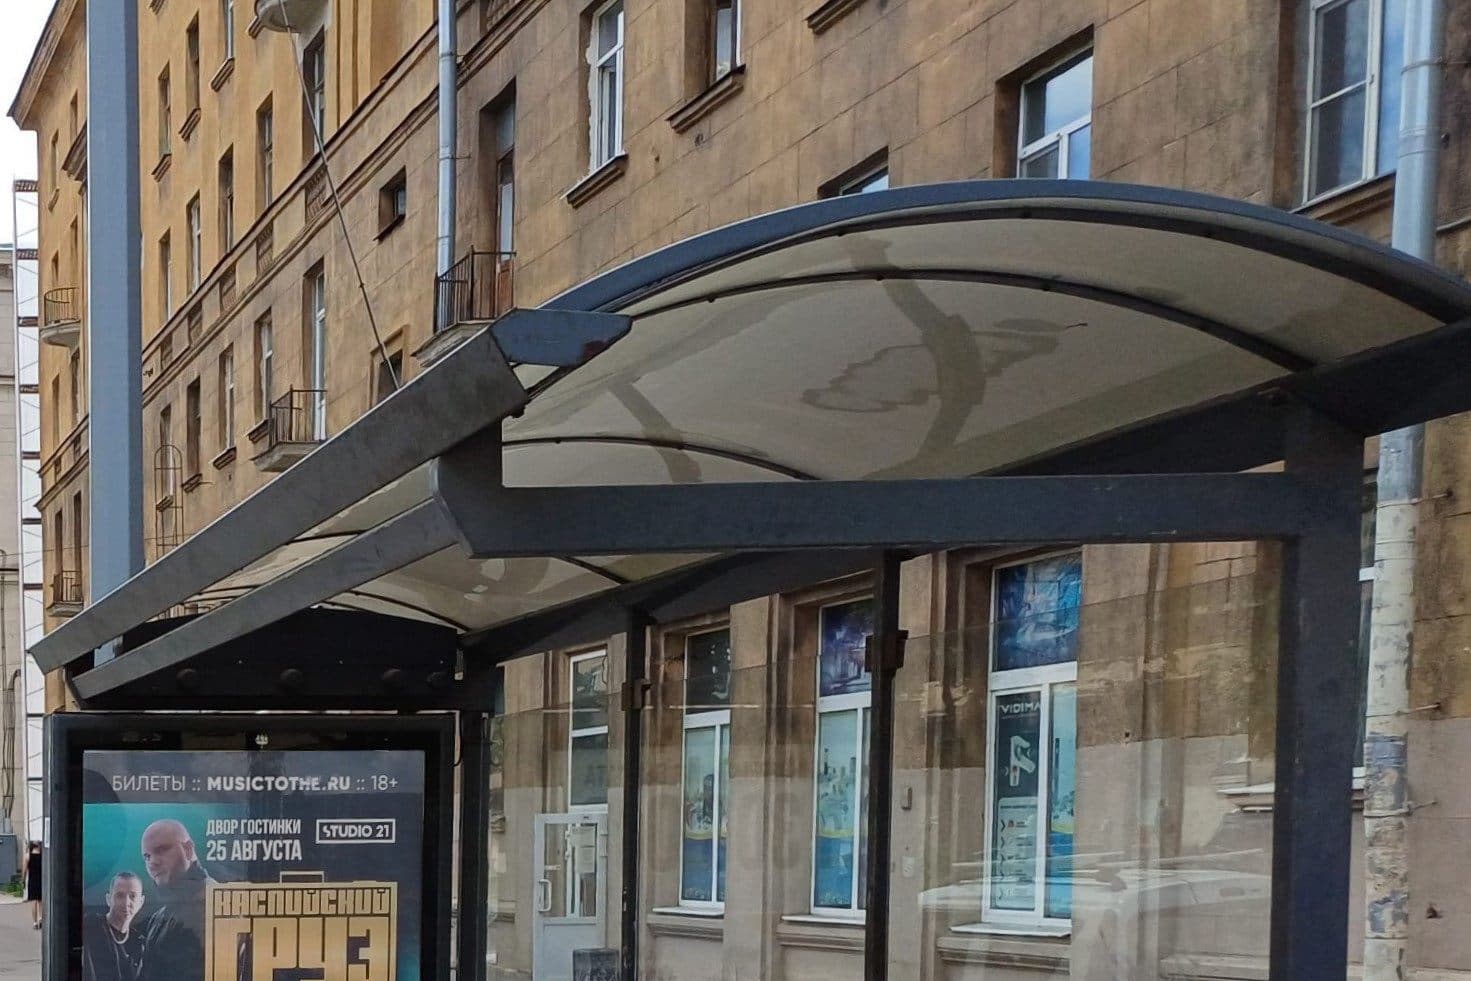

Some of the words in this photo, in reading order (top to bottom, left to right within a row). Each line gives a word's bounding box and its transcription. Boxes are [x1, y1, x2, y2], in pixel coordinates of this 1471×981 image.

[112, 775, 186, 792] БИЛЕТЫ
[207, 776, 350, 791] MUSICTOTHE.RU
[371, 775, 398, 791] 18+
[206, 820, 237, 836] ДВОР
[240, 819, 301, 835] ГОСТИНКИ
[322, 825, 373, 838] STUDIO
[376, 824, 390, 837] 21
[206, 841, 227, 861] 25
[231, 840, 303, 861] АВГУСТА
[214, 889, 390, 915] КАСПИЙСКИЙ
